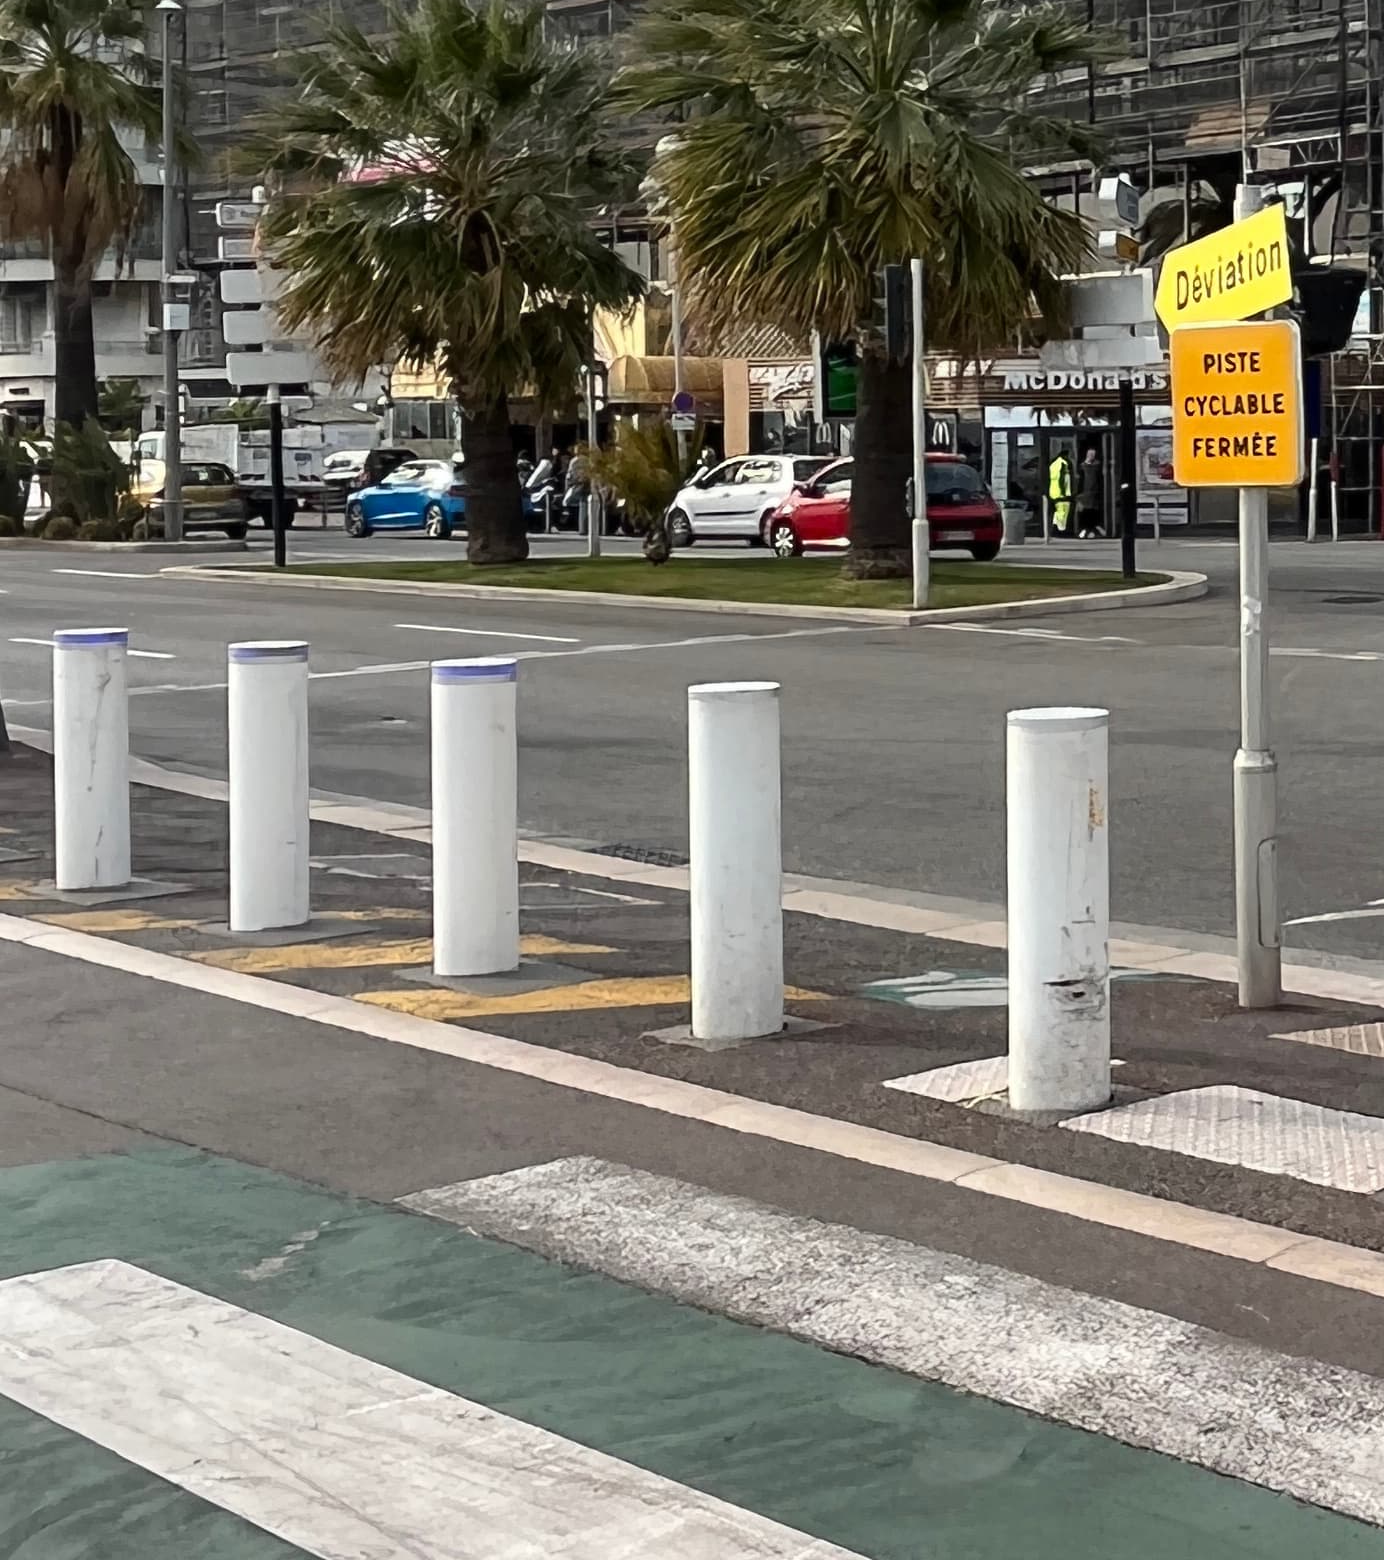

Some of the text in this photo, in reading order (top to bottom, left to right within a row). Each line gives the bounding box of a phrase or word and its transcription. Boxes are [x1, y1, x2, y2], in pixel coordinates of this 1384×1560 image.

[1176, 240, 1281, 311] Déviation
[1203, 352, 1261, 374] PISTE
[1003, 370, 1168, 390] McDonad's
[1184, 393, 1285, 417] CYCLABLE
[1193, 432, 1277, 458] FERMÉE
